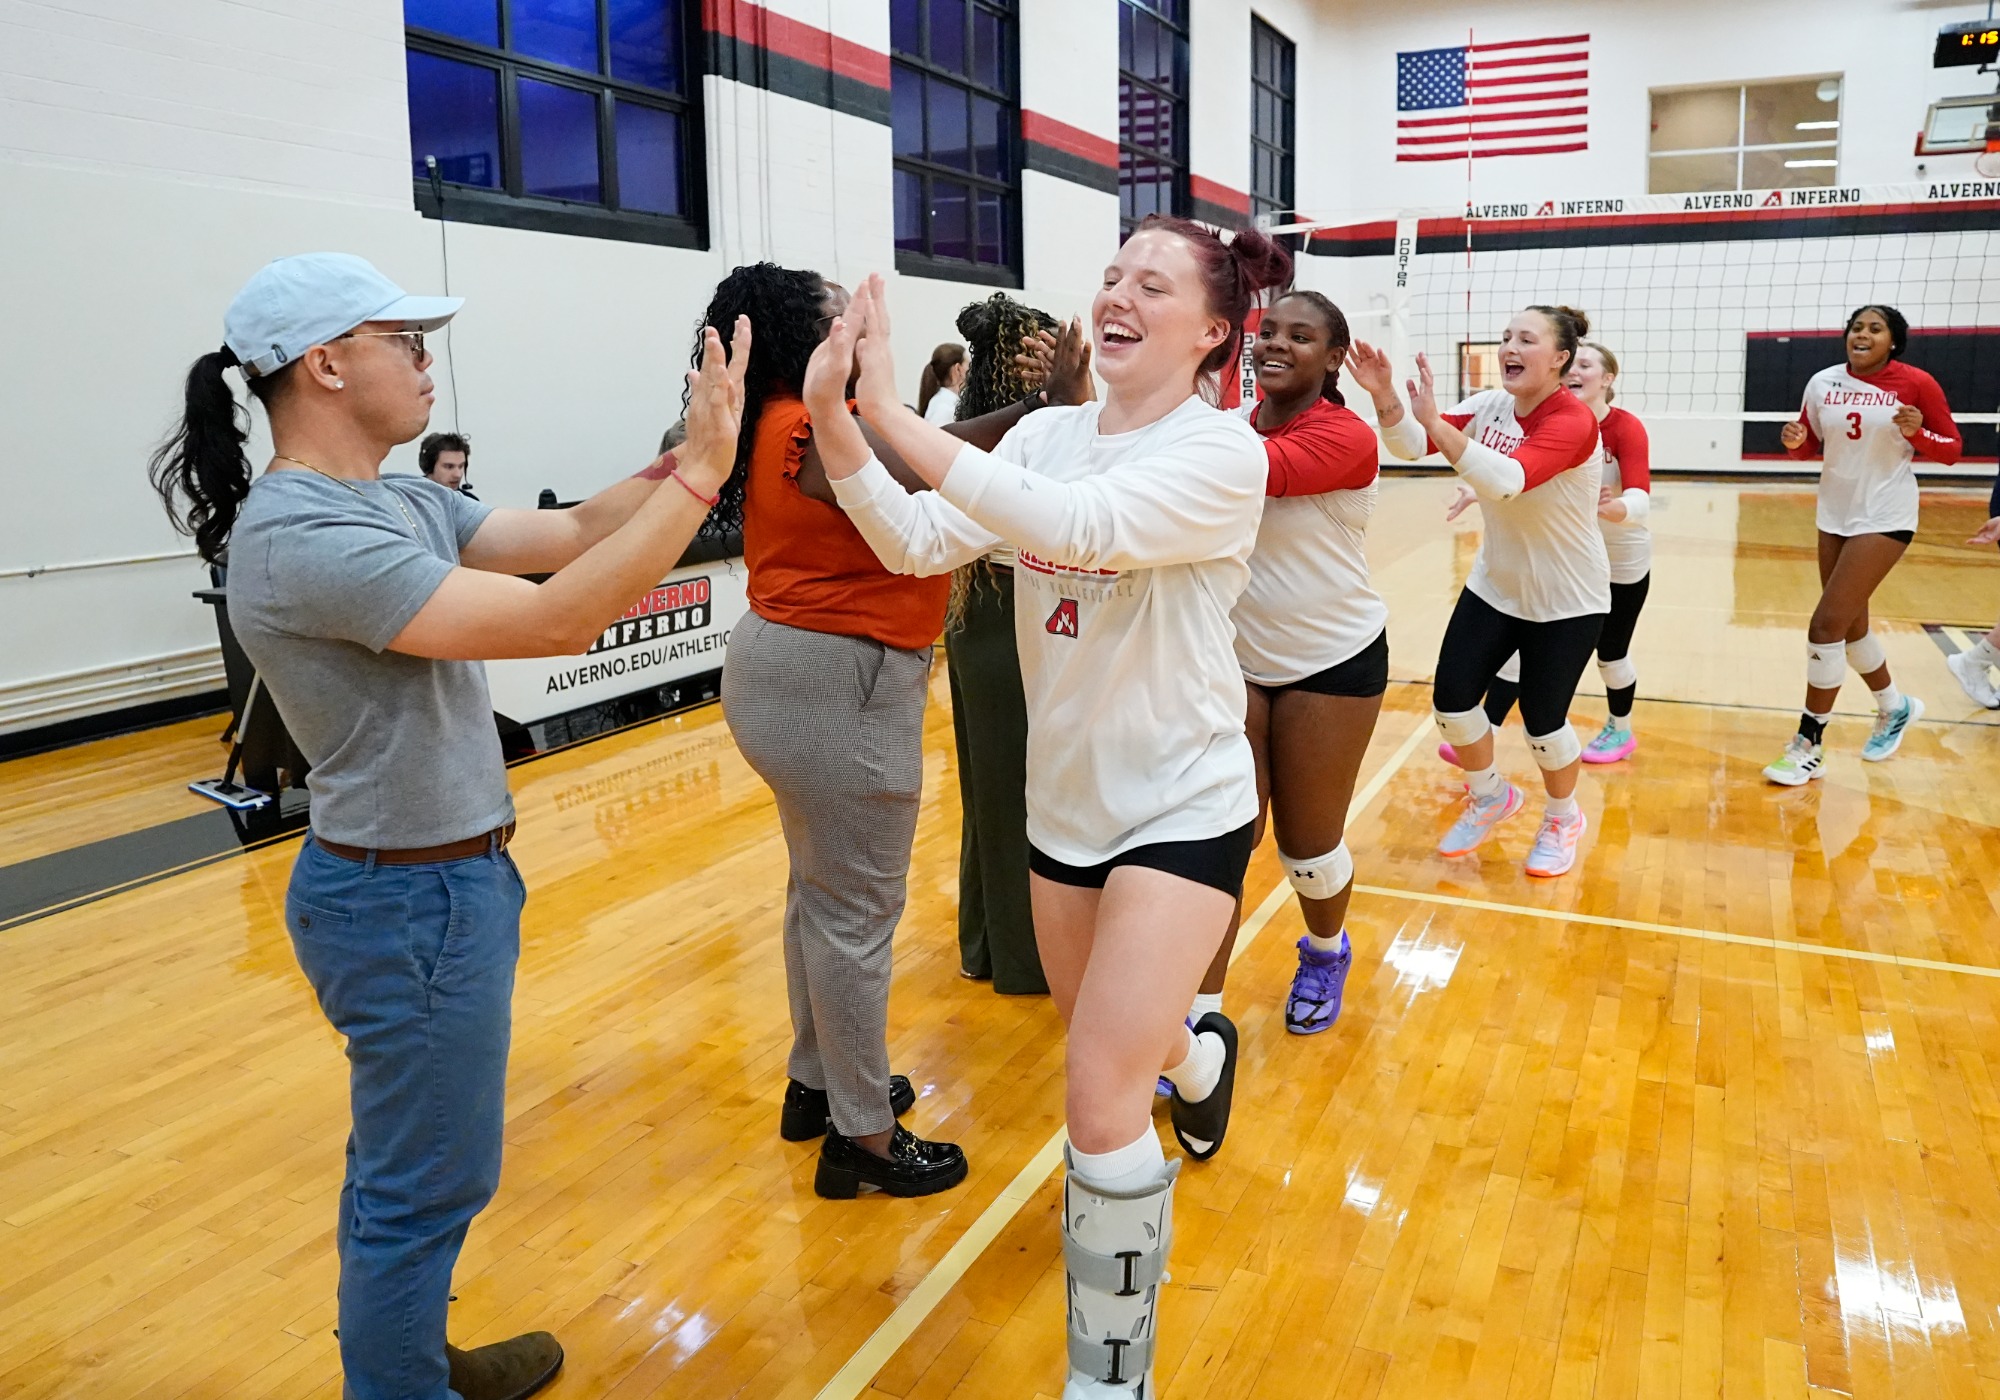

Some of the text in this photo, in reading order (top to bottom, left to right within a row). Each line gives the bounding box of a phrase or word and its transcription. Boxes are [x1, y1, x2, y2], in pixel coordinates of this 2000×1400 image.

[1466, 204, 1528, 218] ALVERNO
[1561, 199, 1624, 215] INFERNO
[1684, 194, 1753, 210] ALVERNO
[1791, 188, 1861, 205] INFERNO
[1824, 391, 1897, 406] ALVERNO
[1846, 412, 1862, 440] 3
